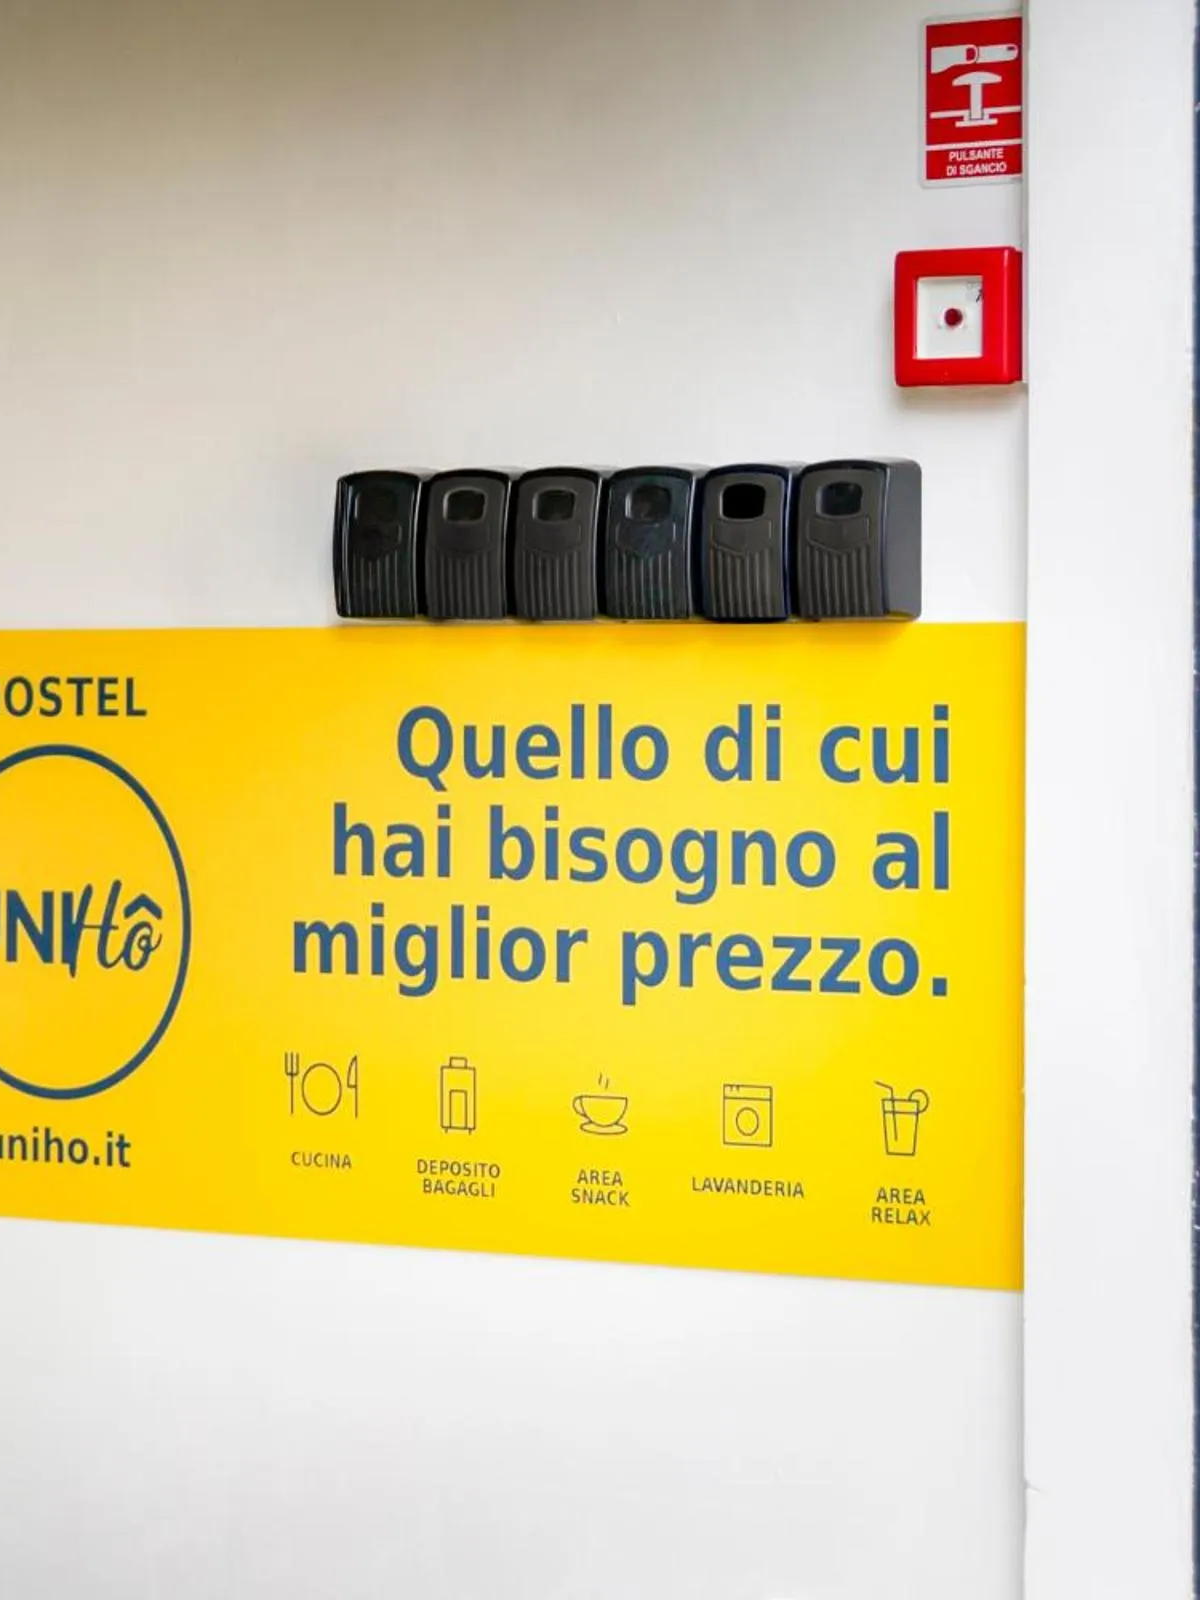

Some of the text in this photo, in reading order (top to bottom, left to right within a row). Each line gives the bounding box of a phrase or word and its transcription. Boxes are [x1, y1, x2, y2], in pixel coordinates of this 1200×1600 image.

[948, 148, 1004, 162] PULSANTE
[946, 161, 1007, 176] DI SGANCIO
[397, 703, 949, 792] Quello di cui
[333, 801, 949, 905] hai bisogno al
[293, 902, 947, 1006] miglior prezzo.
[291, 1151, 353, 1169] CUCINA
[417, 1158, 502, 1179] DEPOSITO
[576, 1168, 624, 1187] AREA
[692, 1176, 805, 1198] LAVANDERIA
[422, 1178, 496, 1198] BAGAGLI
[571, 1188, 631, 1207] SNACK
[876, 1187, 926, 1206] AREA
[871, 1206, 932, 1226] RELAX
